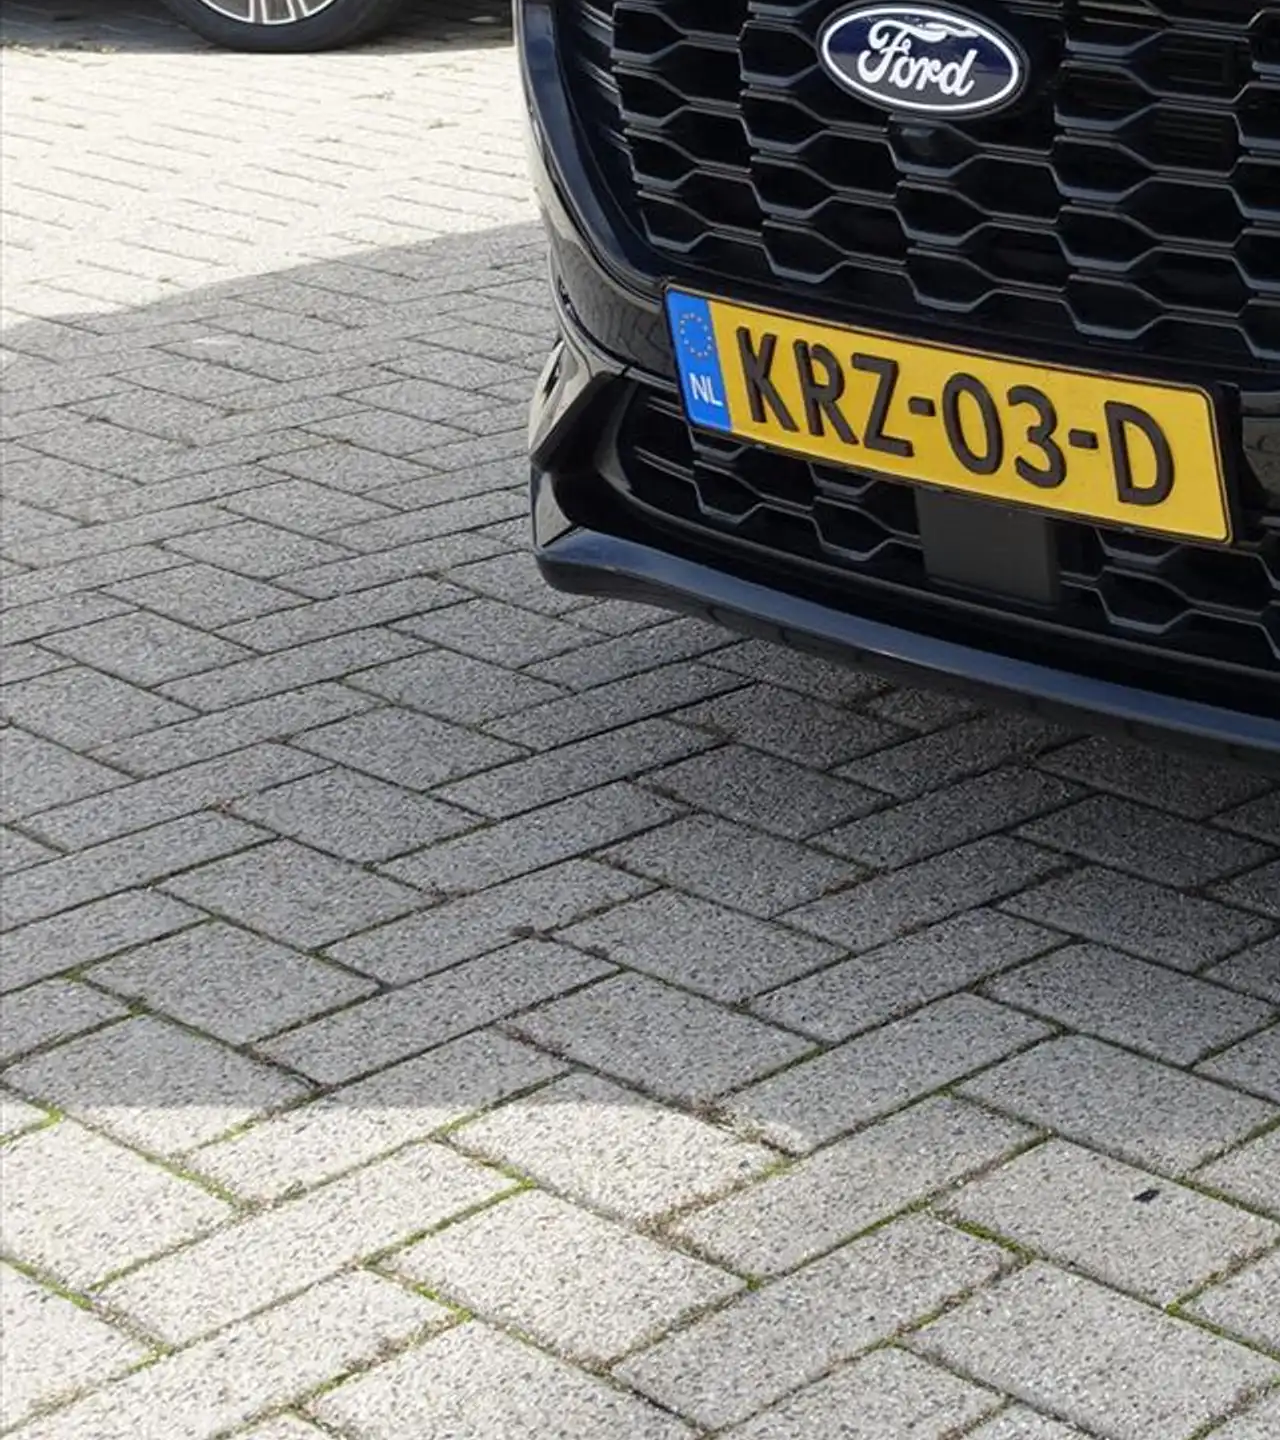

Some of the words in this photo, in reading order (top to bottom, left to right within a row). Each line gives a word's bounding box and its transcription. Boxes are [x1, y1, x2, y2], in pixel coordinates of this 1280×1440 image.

[855, 17, 979, 99] Ford
[688, 372, 724, 408] NL
[735, 326, 1175, 507] KRZ-03-D
